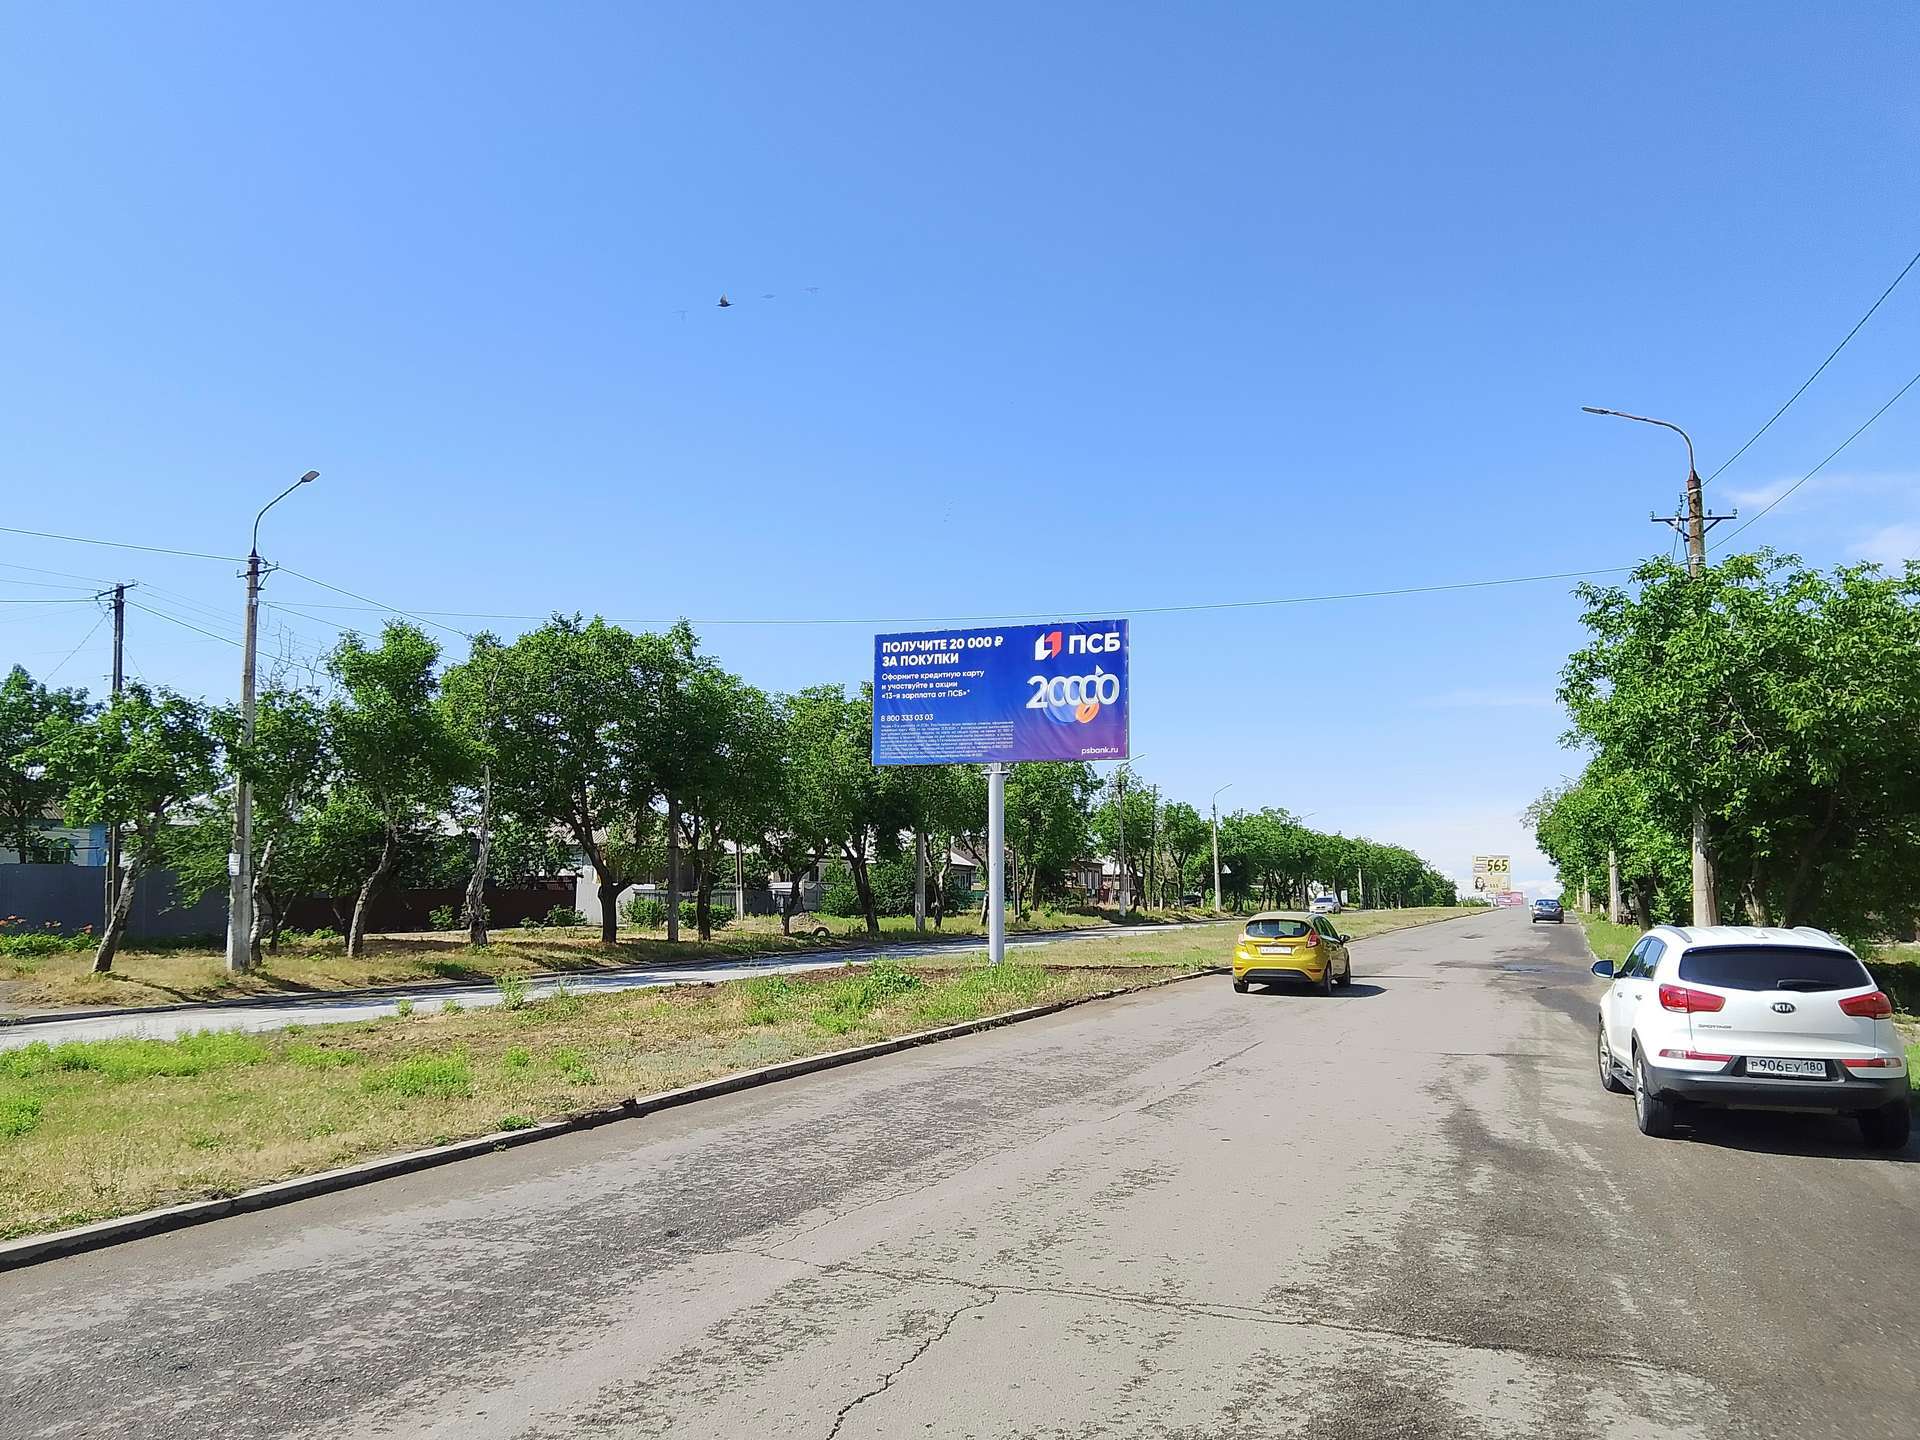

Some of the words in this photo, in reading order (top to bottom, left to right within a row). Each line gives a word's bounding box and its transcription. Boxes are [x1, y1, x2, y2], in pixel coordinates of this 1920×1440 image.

[882, 640, 947, 653] ПОЛУЧИТЕ
[949, 639, 965, 650] 20
[967, 637, 992, 649] 000
[1068, 632, 1121, 654] ПСБ
[882, 656, 898, 667] ЗА
[900, 653, 959, 666] ПОКУПКИ
[882, 673, 919, 681] Оформите
[920, 671, 961, 680] кредитную
[962, 670, 985, 678] карту
[888, 682, 928, 692] участвуйте
[935, 681, 958, 689] акции
[901, 692, 937, 700] зарплата
[1081, 747, 1119, 755] psbank.ru
[1487, 859, 1509, 872] 565
[1774, 1003, 1793, 1012] KIA
[1803, 1061, 1823, 1072] 180
